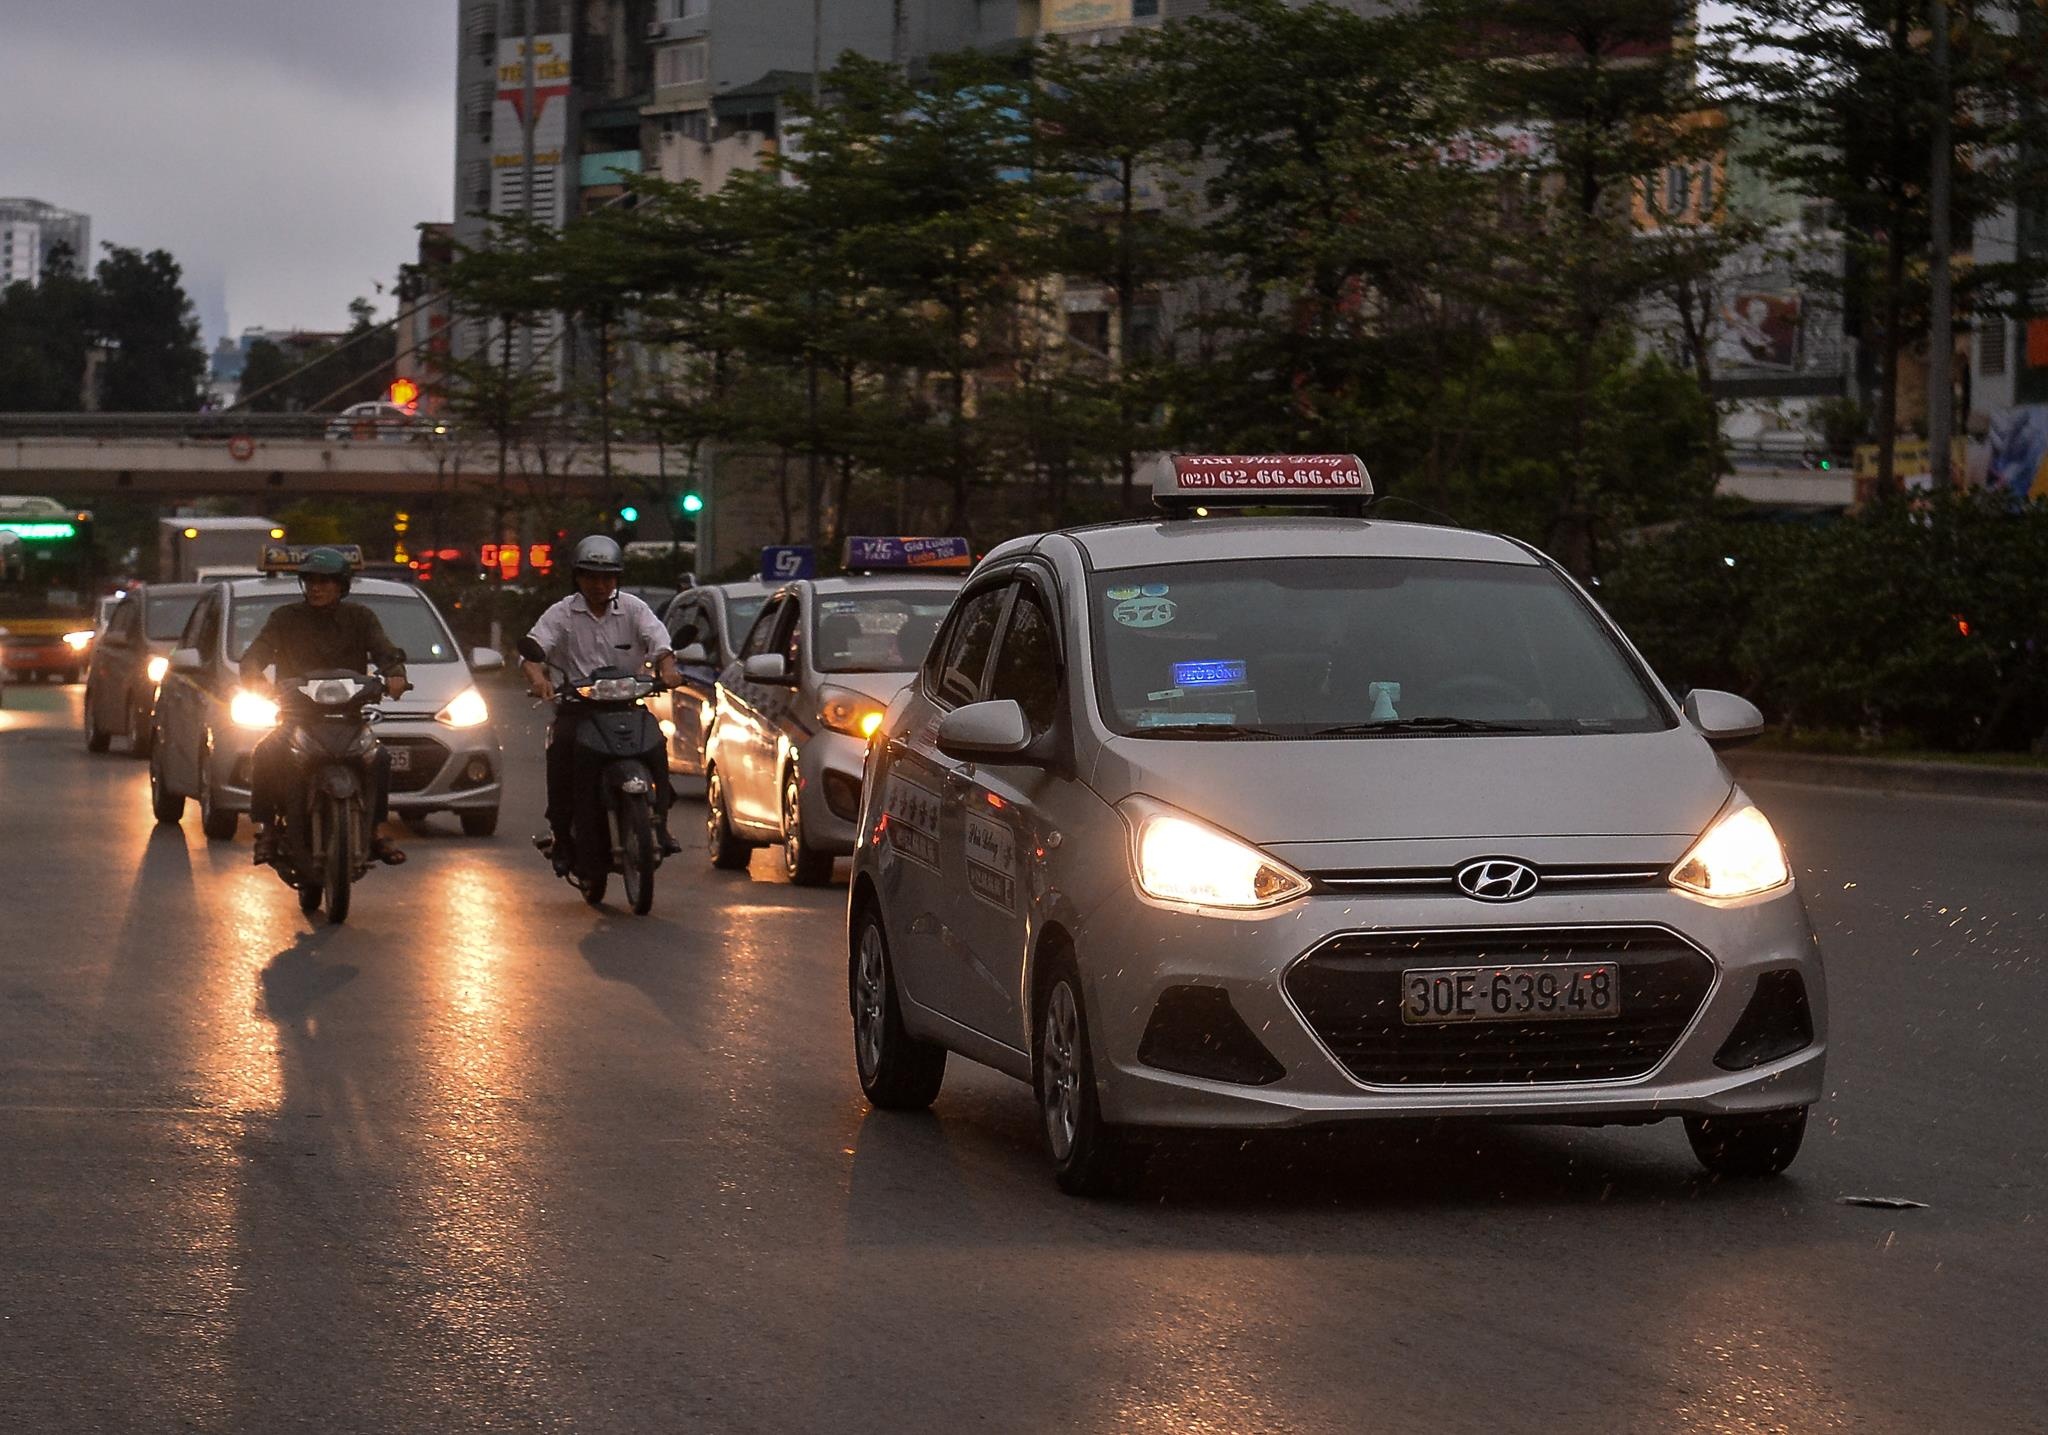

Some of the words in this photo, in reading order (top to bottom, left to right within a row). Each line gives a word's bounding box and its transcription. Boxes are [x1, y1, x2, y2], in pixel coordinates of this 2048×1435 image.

[1189, 457, 1233, 465] TAXI
[1180, 472, 1216, 486] (024)
[1219, 469, 1360, 485] 62.66.66.66
[1410, 970, 1611, 1016] 30E-639.48
